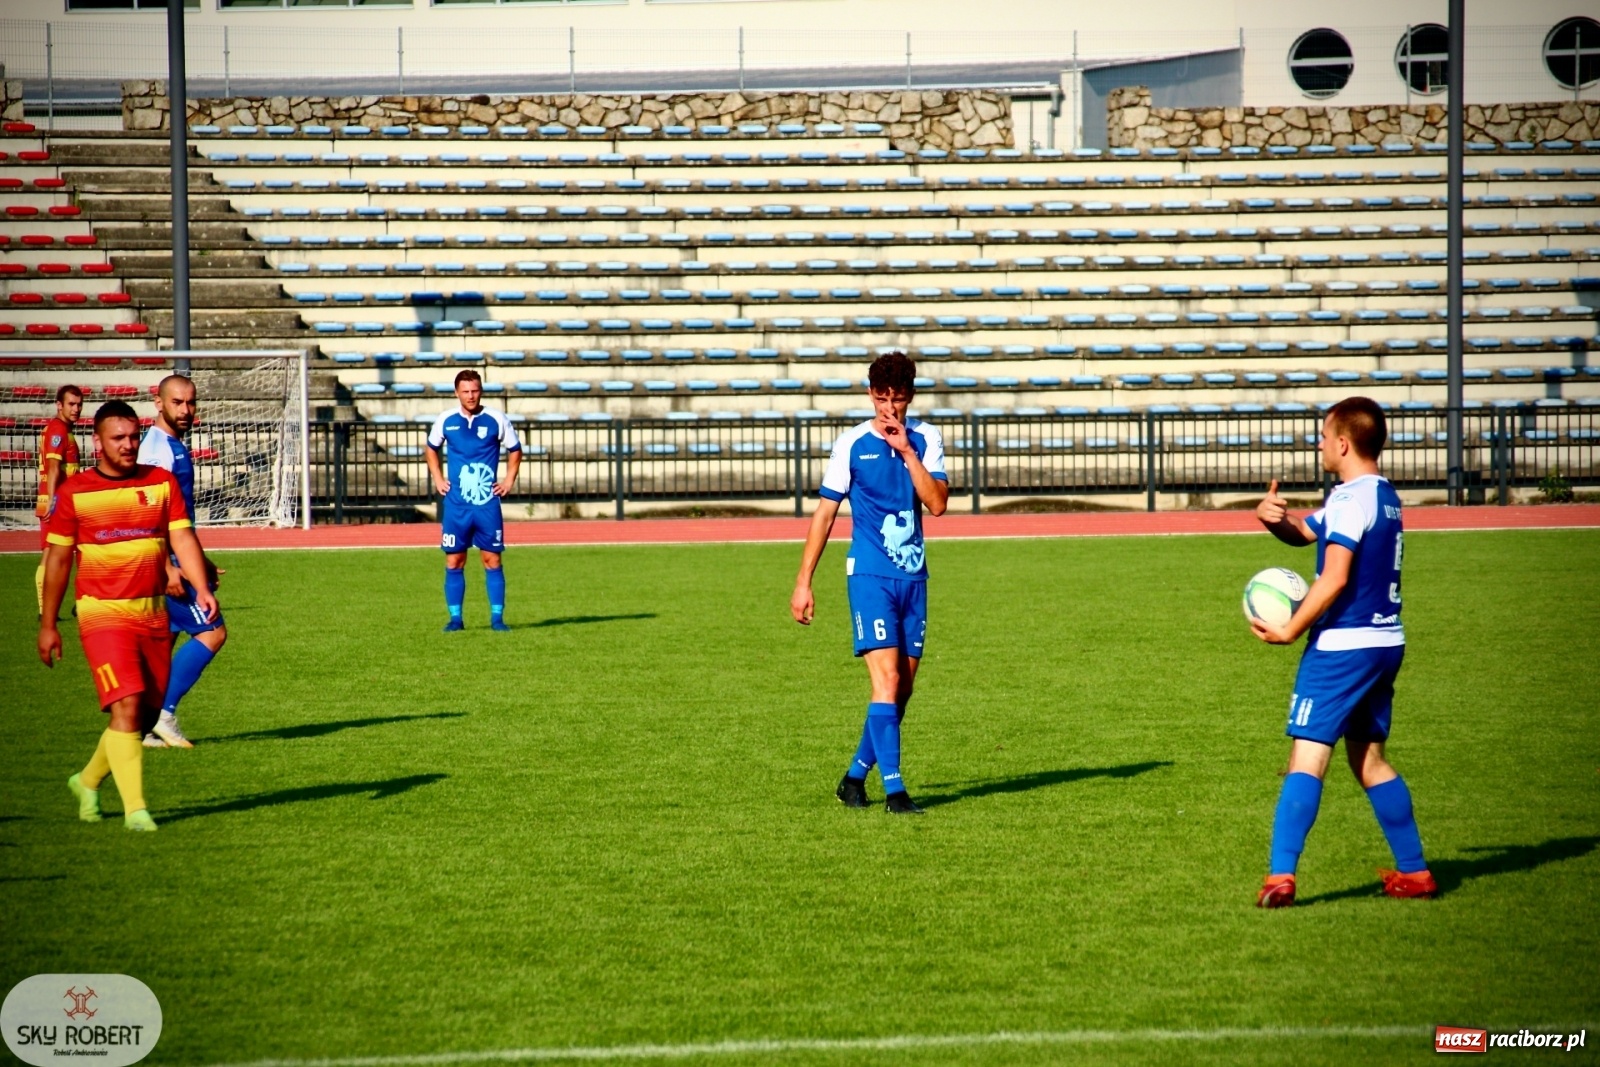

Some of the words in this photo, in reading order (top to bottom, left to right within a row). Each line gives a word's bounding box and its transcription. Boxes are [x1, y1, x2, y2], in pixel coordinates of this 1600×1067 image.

[442, 533, 456, 548] 90
[873, 618, 887, 641] 6
[97, 663, 120, 693] 11
